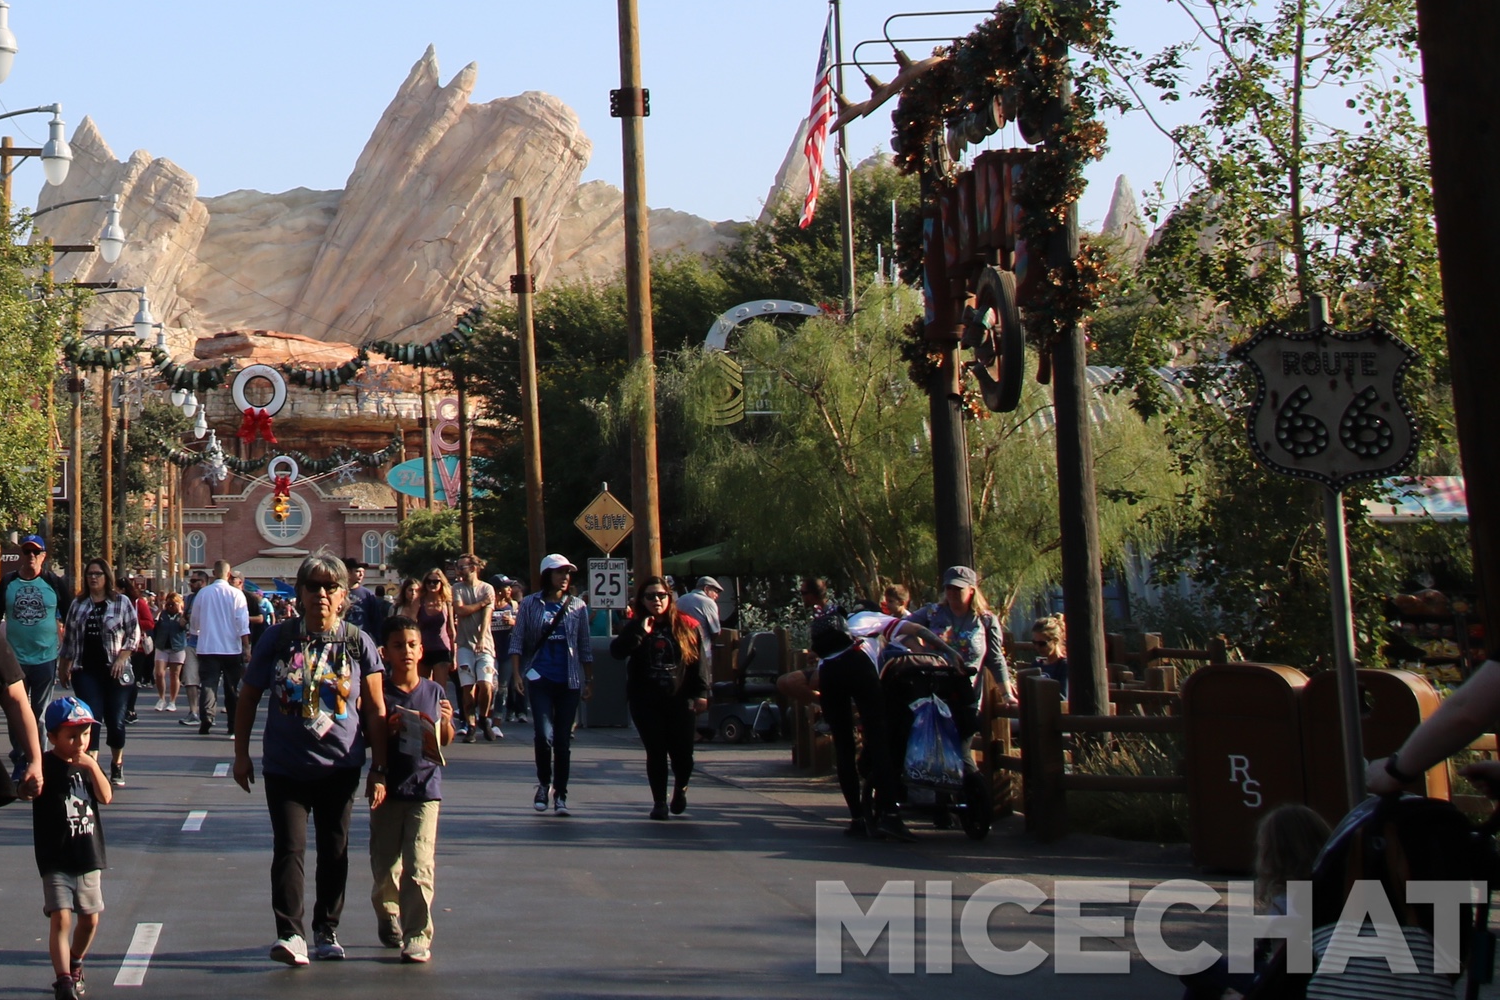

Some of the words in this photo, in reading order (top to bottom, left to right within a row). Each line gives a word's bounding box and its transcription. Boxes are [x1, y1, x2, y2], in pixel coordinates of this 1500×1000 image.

[1282, 351, 1378, 376] ROUTE
[1274, 384, 1394, 457] 66
[584, 513, 627, 531] SLOW
[590, 562, 608, 570] SPEED
[608, 562, 624, 570] LIMIT
[594, 572, 621, 596] 25
[600, 598, 614, 606] MPH
